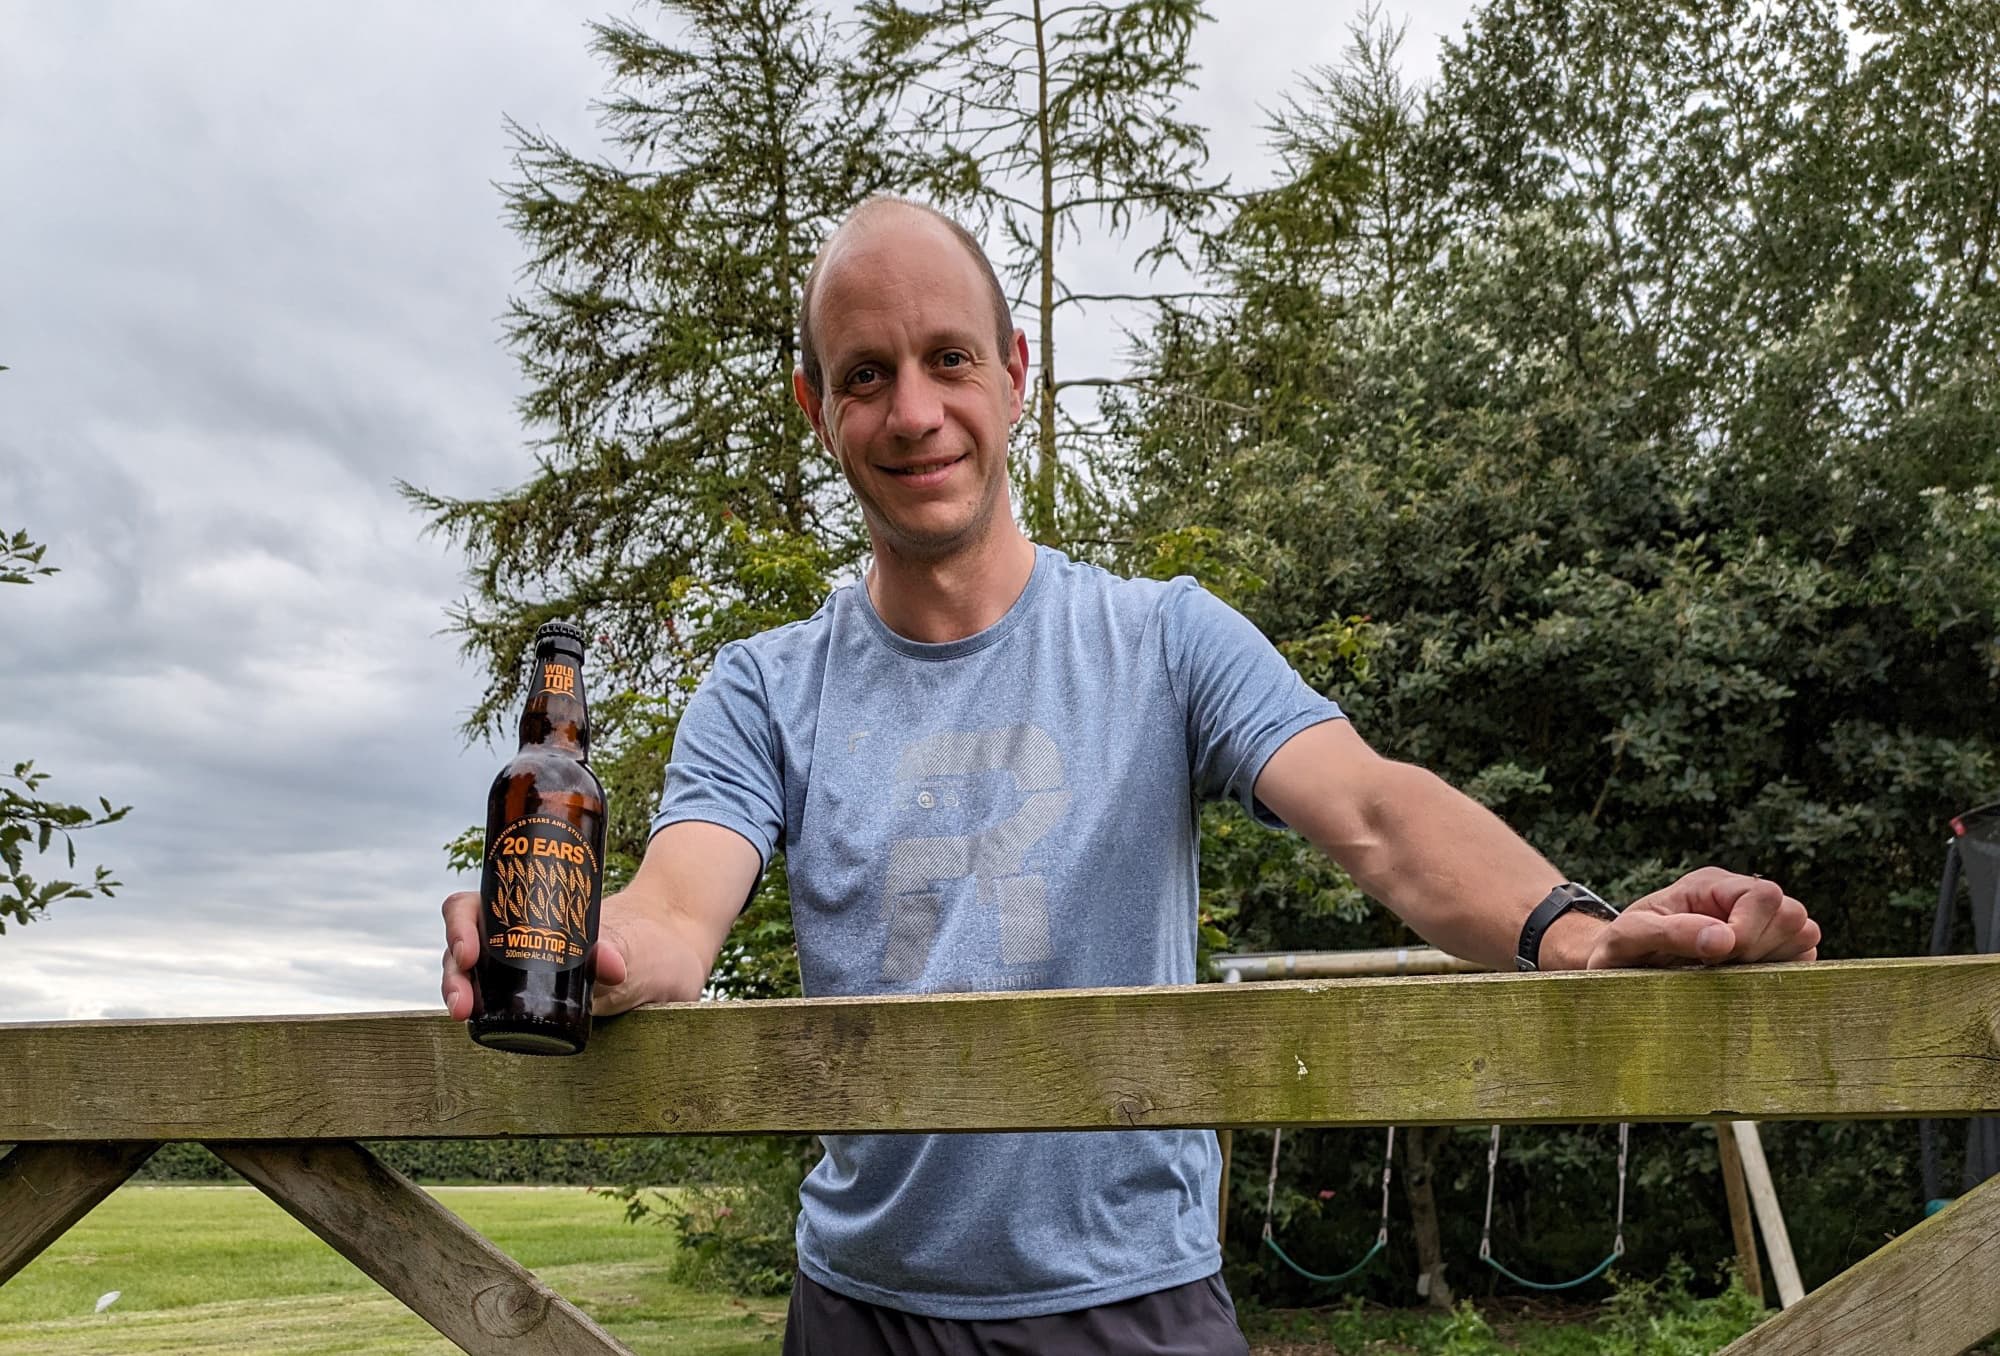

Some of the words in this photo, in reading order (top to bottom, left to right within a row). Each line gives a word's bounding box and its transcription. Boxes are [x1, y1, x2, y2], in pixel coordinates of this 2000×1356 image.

[544, 664, 574, 677] WOLD
[517, 819, 527, 827] 20
[551, 819, 567, 829] AND
[567, 826, 583, 842] STILL
[502, 836, 529, 855] 20
[533, 837, 584, 865] EARS
[507, 933, 543, 949] WOLD
